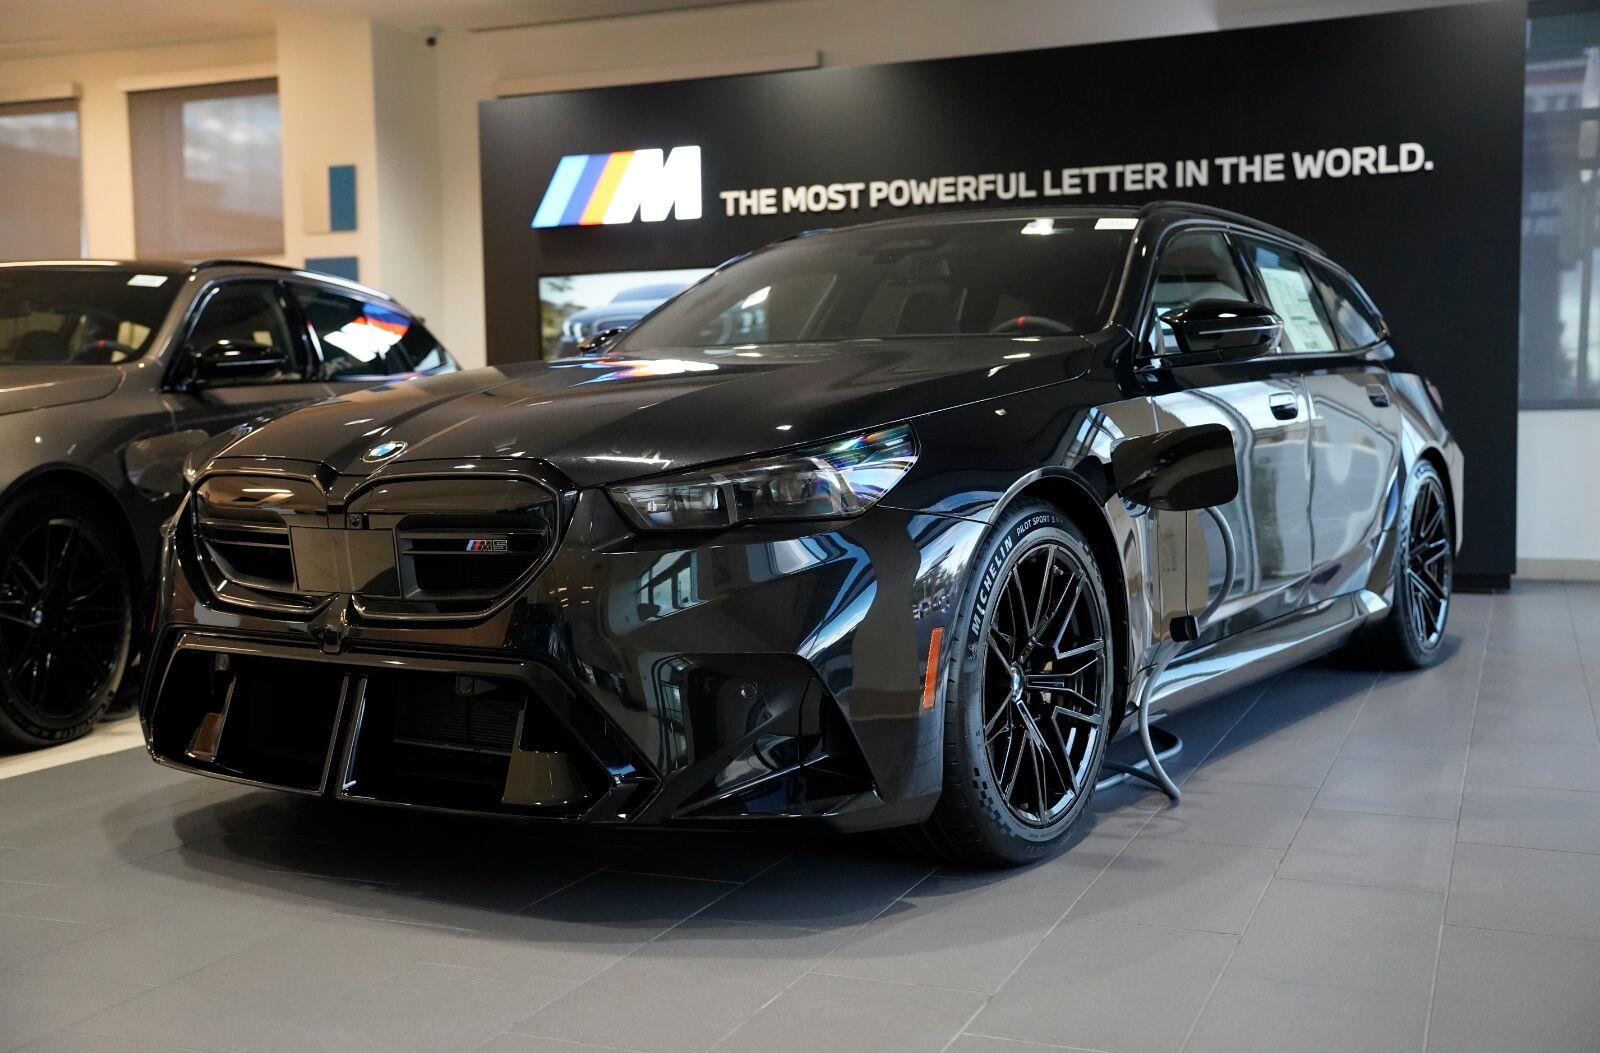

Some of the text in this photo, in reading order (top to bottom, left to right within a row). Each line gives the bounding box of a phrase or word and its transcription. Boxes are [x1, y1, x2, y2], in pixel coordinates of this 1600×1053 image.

[719, 142, 1435, 217] THE MOST POWERFUL LETTER IN THE WORLD.
[479, 539, 508, 552] M5
[1016, 519, 1032, 537] PILOT
[1032, 515, 1050, 526] SPORT
[971, 535, 1013, 636] MICHELIN
